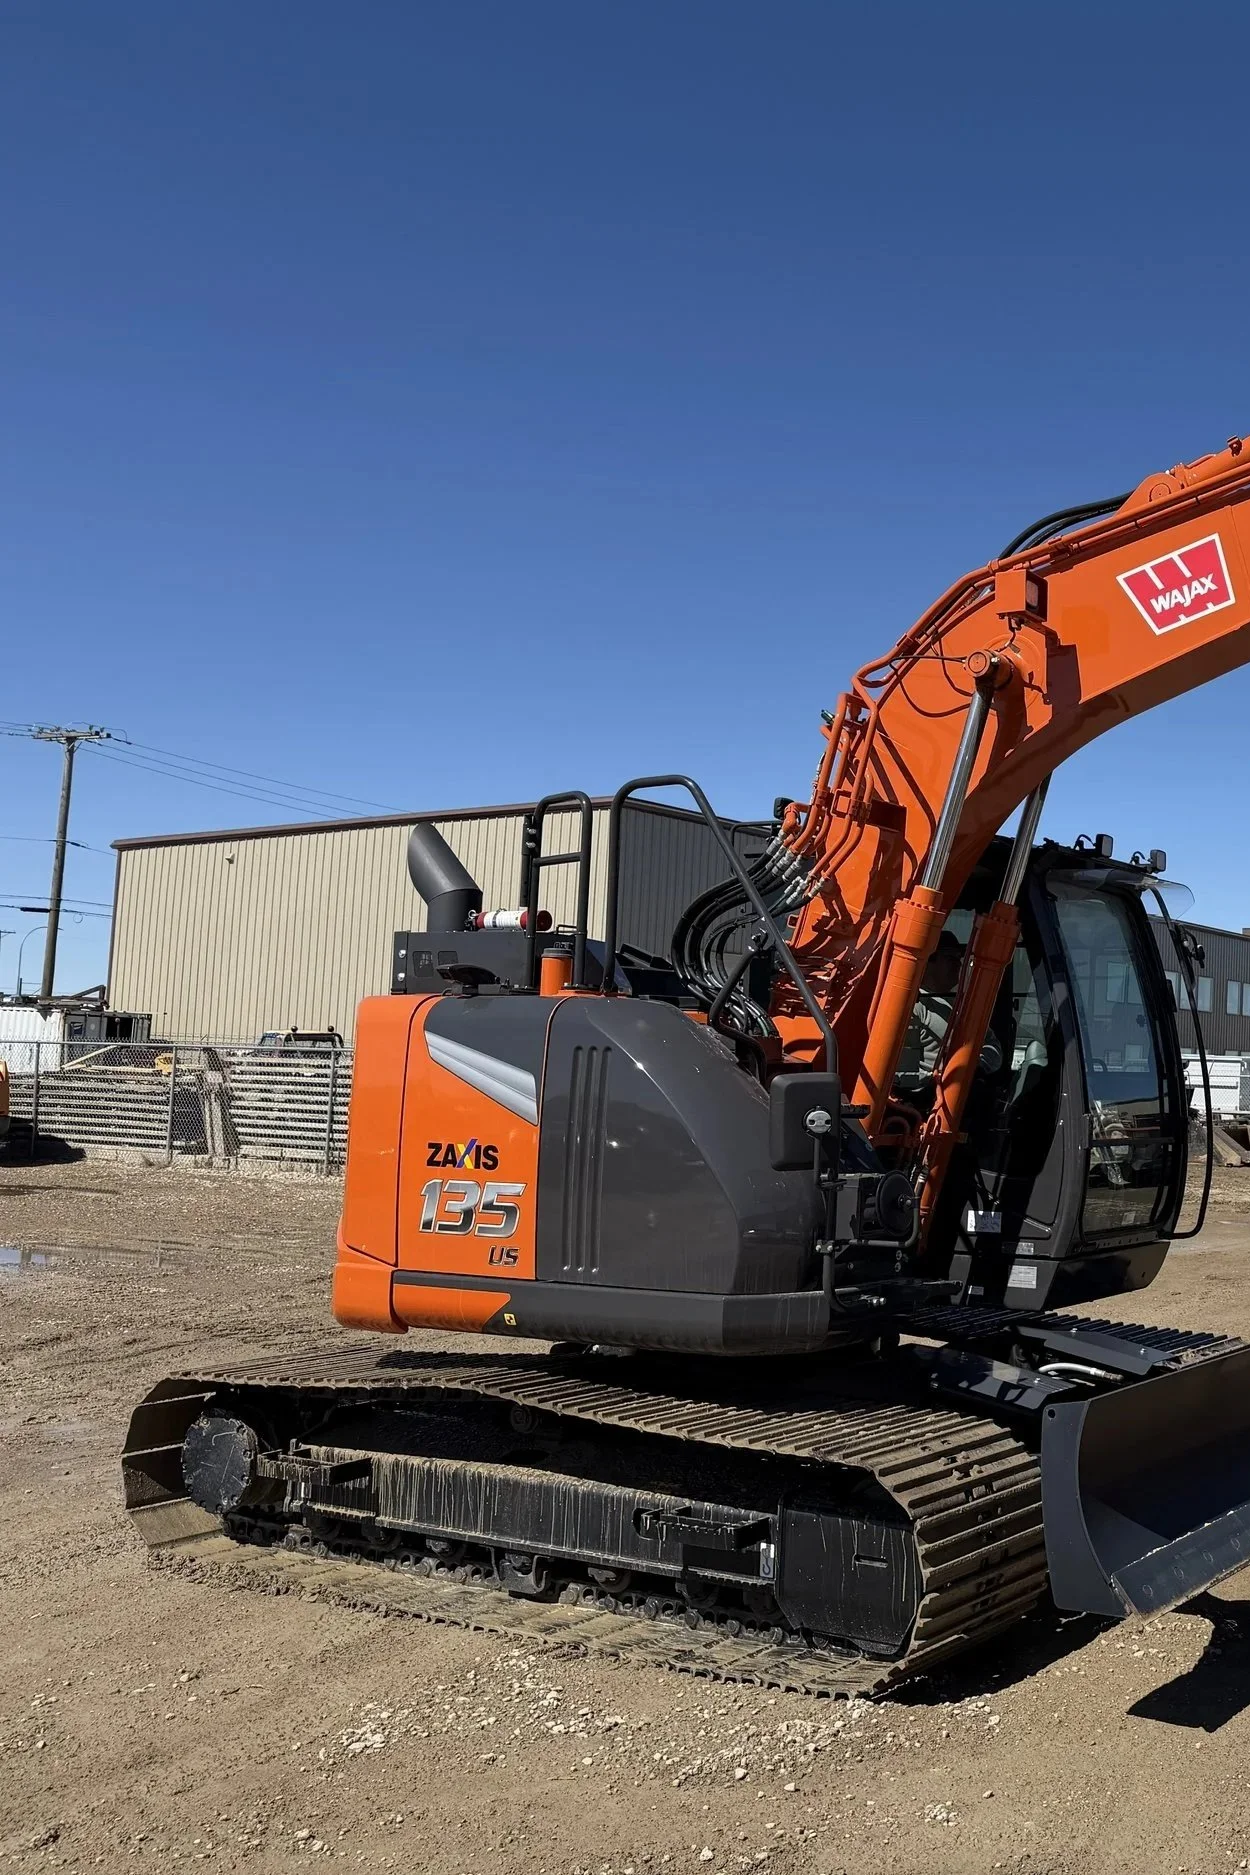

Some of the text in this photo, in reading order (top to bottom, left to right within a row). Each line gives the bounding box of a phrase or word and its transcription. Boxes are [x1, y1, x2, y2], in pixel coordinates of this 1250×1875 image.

[1149, 573, 1219, 614] WAJAX
[426, 1138, 499, 1171] ZAXIS
[419, 1178, 527, 1239] 135
[487, 1245, 520, 1267] US
